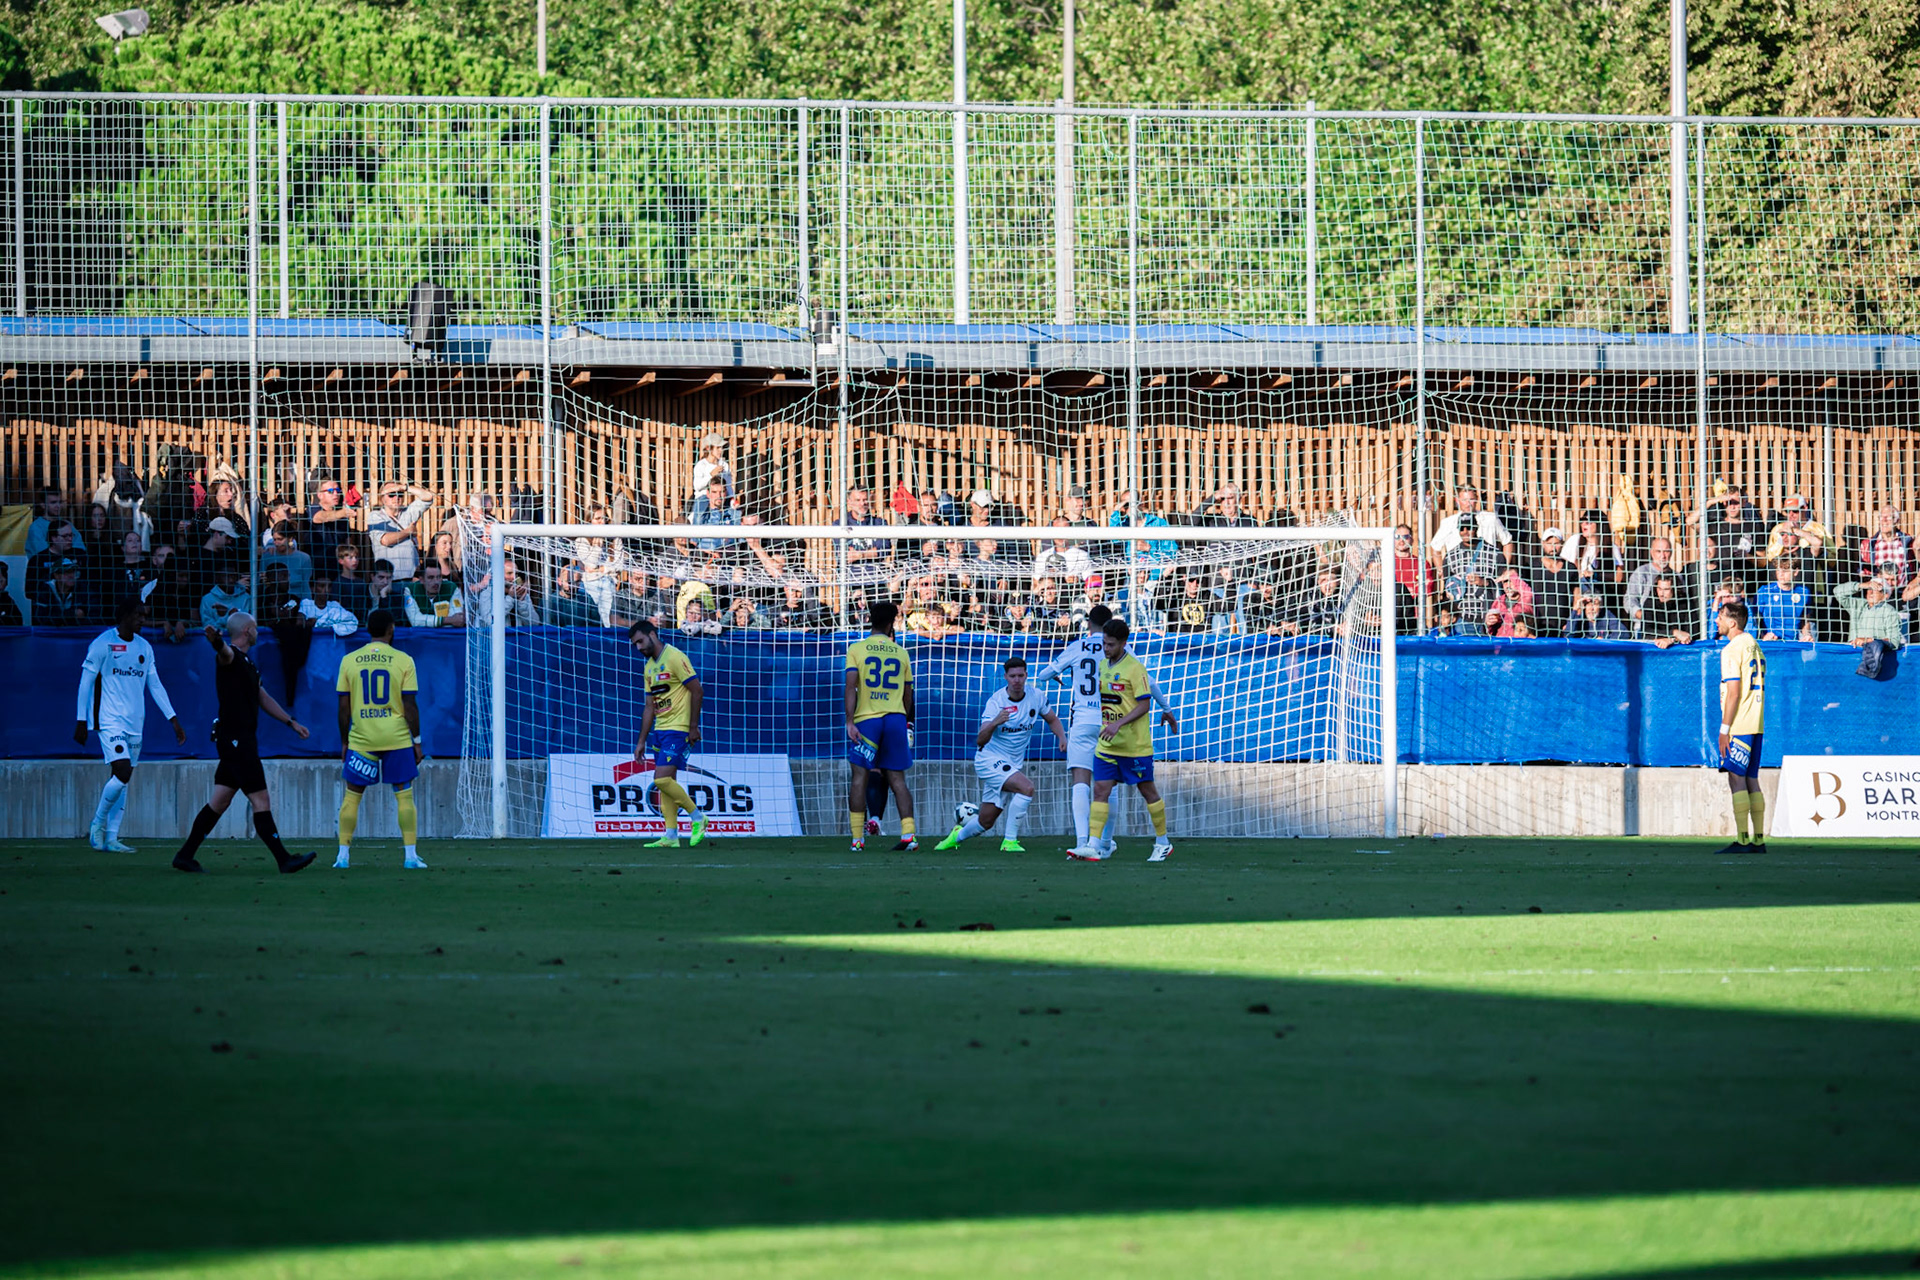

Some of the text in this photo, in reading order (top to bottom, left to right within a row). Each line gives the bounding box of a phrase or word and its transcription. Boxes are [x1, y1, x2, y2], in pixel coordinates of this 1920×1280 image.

[866, 644, 898, 653] OBRIST
[355, 653, 394, 664] OBRIST
[864, 656, 901, 690] 32
[1080, 658, 1101, 696] 3
[360, 668, 390, 705] 10
[870, 691, 889, 701] ZUVIC
[1730, 747, 1750, 768] 200
[348, 755, 378, 779] 2000
[1864, 787, 1918, 805] BAR
[1866, 810, 1920, 821] MONTR
[597, 823, 753, 831] GLOBAL EURITE
